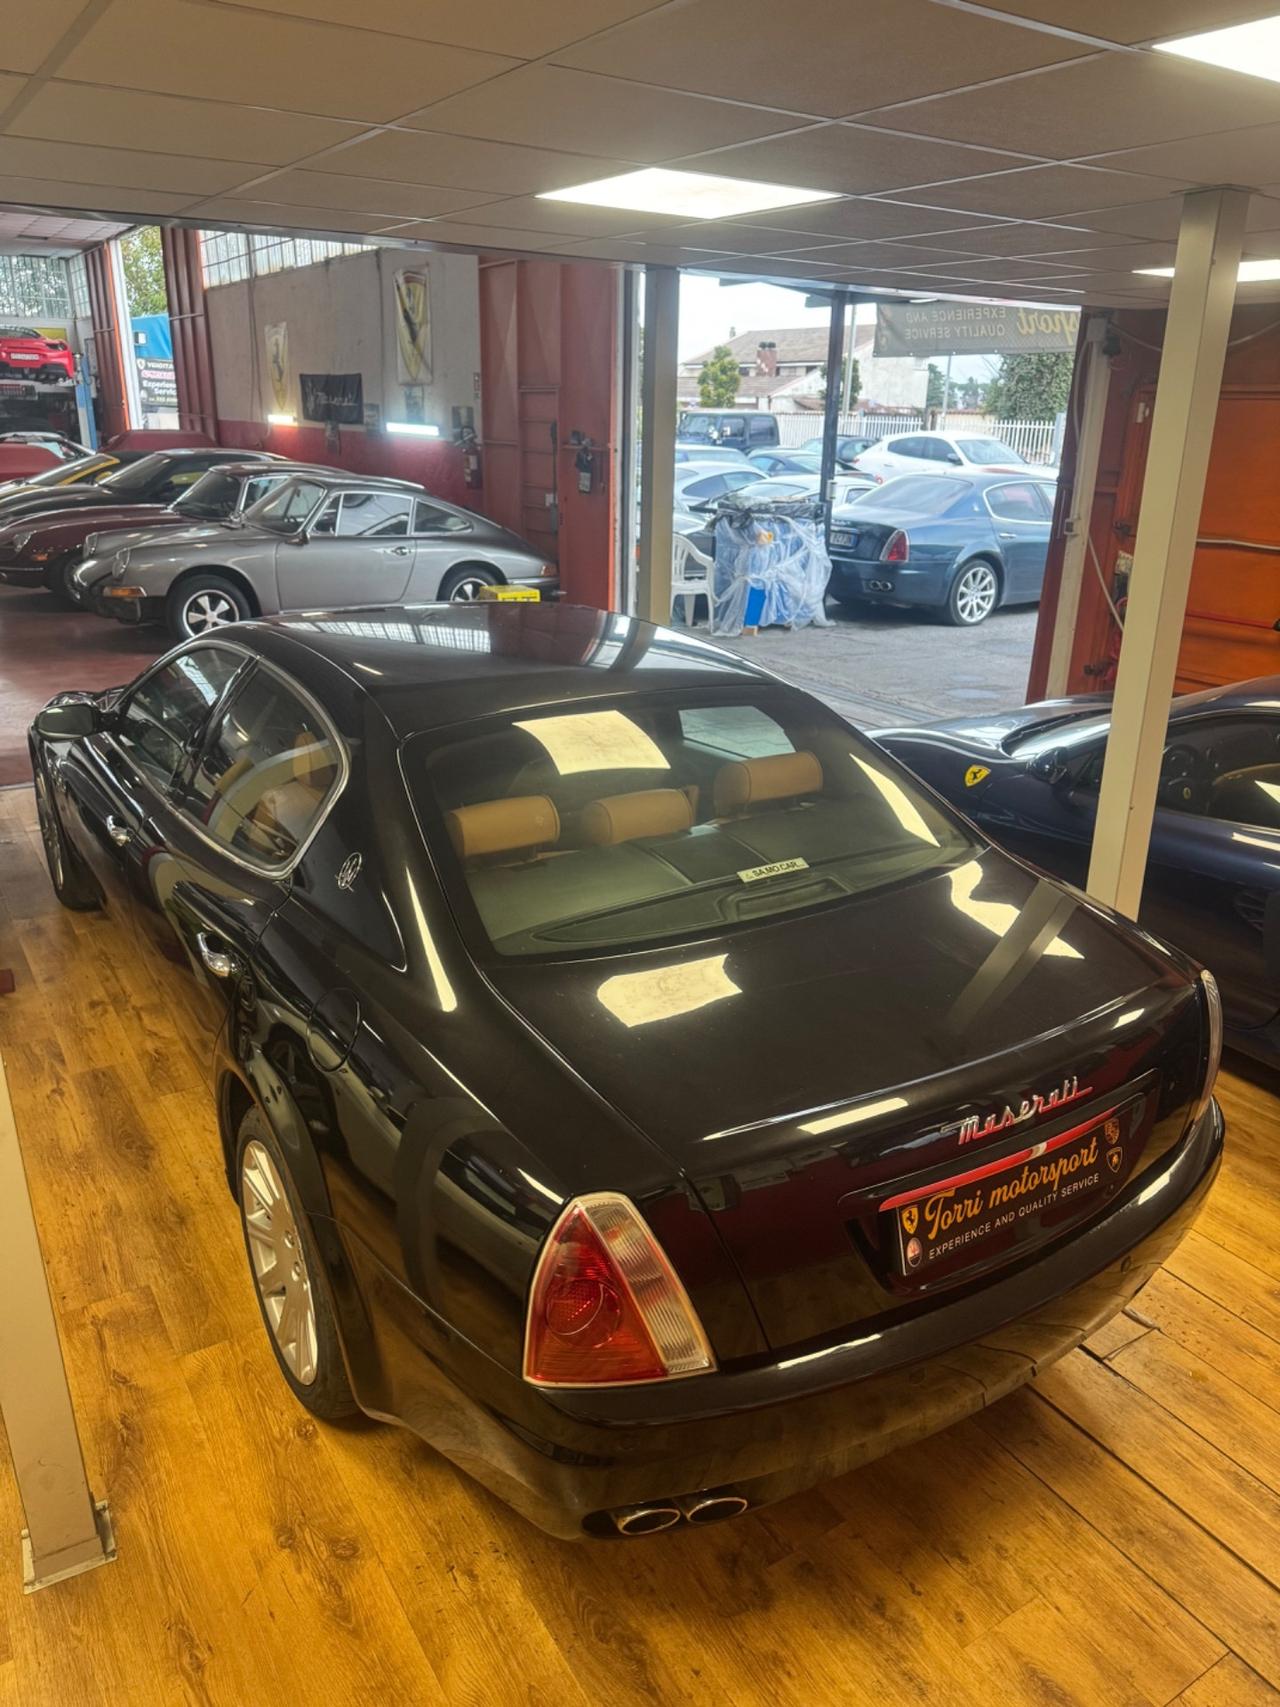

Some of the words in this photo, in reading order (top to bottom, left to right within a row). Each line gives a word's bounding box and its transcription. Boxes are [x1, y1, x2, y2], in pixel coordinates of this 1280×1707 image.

[958, 1076, 1093, 1146] Maserati
[925, 1187, 984, 1240] Torri
[988, 1136, 1099, 1209] motorsport
[929, 1221, 991, 1260] EXPERIENCE
[994, 1211, 1015, 1228] AND
[1018, 1191, 1058, 1217] QUALITY
[1061, 1172, 1100, 1198] SERVICE
